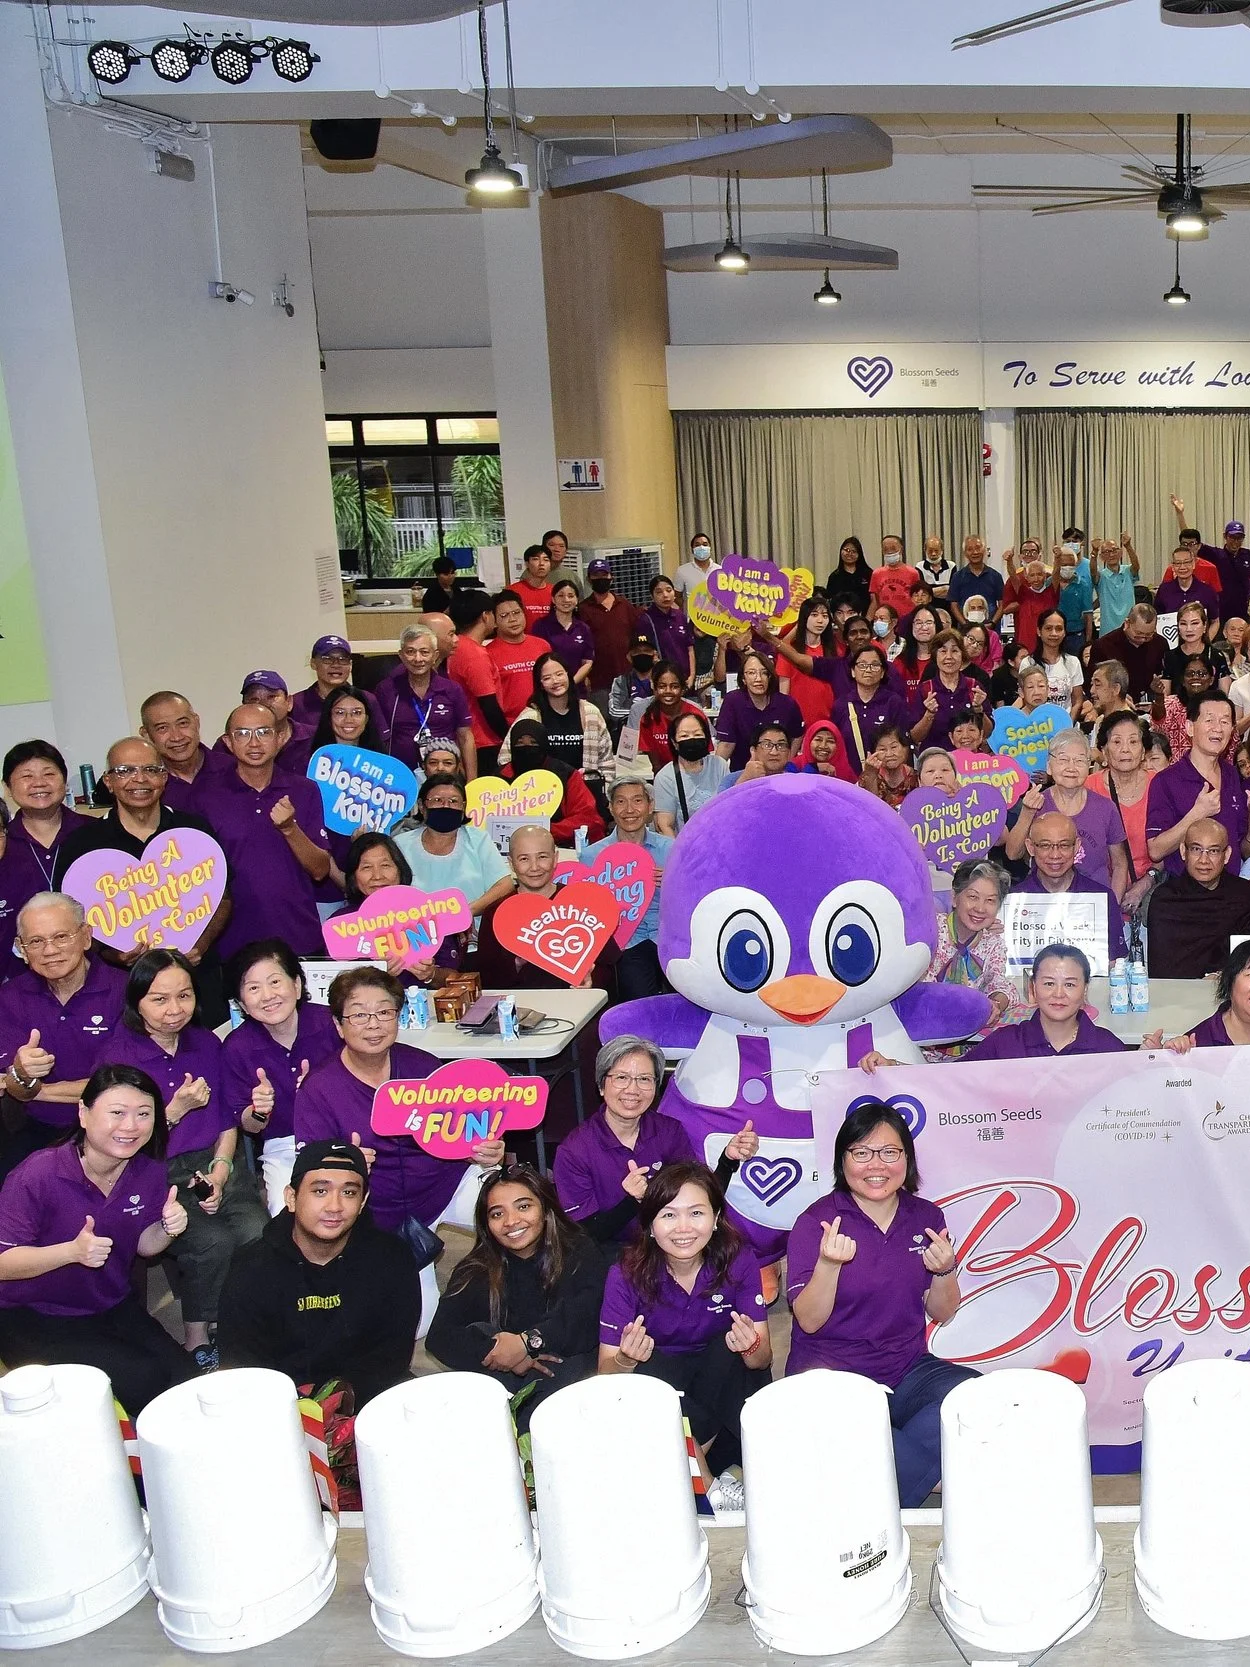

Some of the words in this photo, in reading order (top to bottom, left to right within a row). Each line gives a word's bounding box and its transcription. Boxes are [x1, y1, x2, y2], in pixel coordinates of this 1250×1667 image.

[899, 368, 934, 377] Blossom
[935, 367, 960, 377] Seeds
[1003, 361, 1038, 387] To
[1050, 362, 1127, 387] Serve
[1138, 360, 1196, 386] with
[738, 566, 743, 577] I
[745, 569, 761, 580] am
[763, 571, 770, 581] a
[717, 573, 784, 600] Blossom
[735, 593, 777, 617] Kaki!
[696, 611, 740, 633] Volunteer
[503, 661, 526, 671] YOUTH
[1006, 717, 1054, 741] Social
[353, 754, 361, 768] I
[361, 761, 383, 780] am
[384, 773, 395, 786] a
[964, 760, 968, 771] I
[971, 759, 989, 770] am
[992, 758, 1000, 769] a
[314, 756, 405, 813] Blossom
[523, 776, 536, 792] A
[479, 787, 518, 806] Being
[965, 789, 979, 809] A
[332, 791, 392, 833] Kaki!
[920, 801, 962, 823] Being
[911, 807, 1000, 847] Volunteer
[161, 839, 182, 868] A
[955, 832, 991, 855] Cool
[95, 861, 159, 899] Being
[86, 858, 216, 937] Volunteer
[161, 895, 213, 932] Cool
[332, 896, 462, 939] Volunteering
[517, 903, 606, 945] Healthier
[356, 935, 372, 955] is
[373, 920, 438, 960] FUN!
[548, 935, 584, 958] SG
[1036, 936, 1045, 945] in
[388, 1082, 538, 1106] Volunteering
[1165, 1079, 1192, 1089] Awarded
[404, 1108, 424, 1131] is
[423, 1110, 503, 1144] FUN!
[938, 1112, 997, 1126] Blossom
[1000, 1107, 1043, 1122] Seeds
[1085, 1120, 1121, 1131] Certificate
[1121, 1120, 1130, 1130] of
[1129, 1119, 1181, 1129] Commendation
[976, 1127, 1005, 1142] 福善
[1114, 1132, 1156, 1142] (COVID-19)
